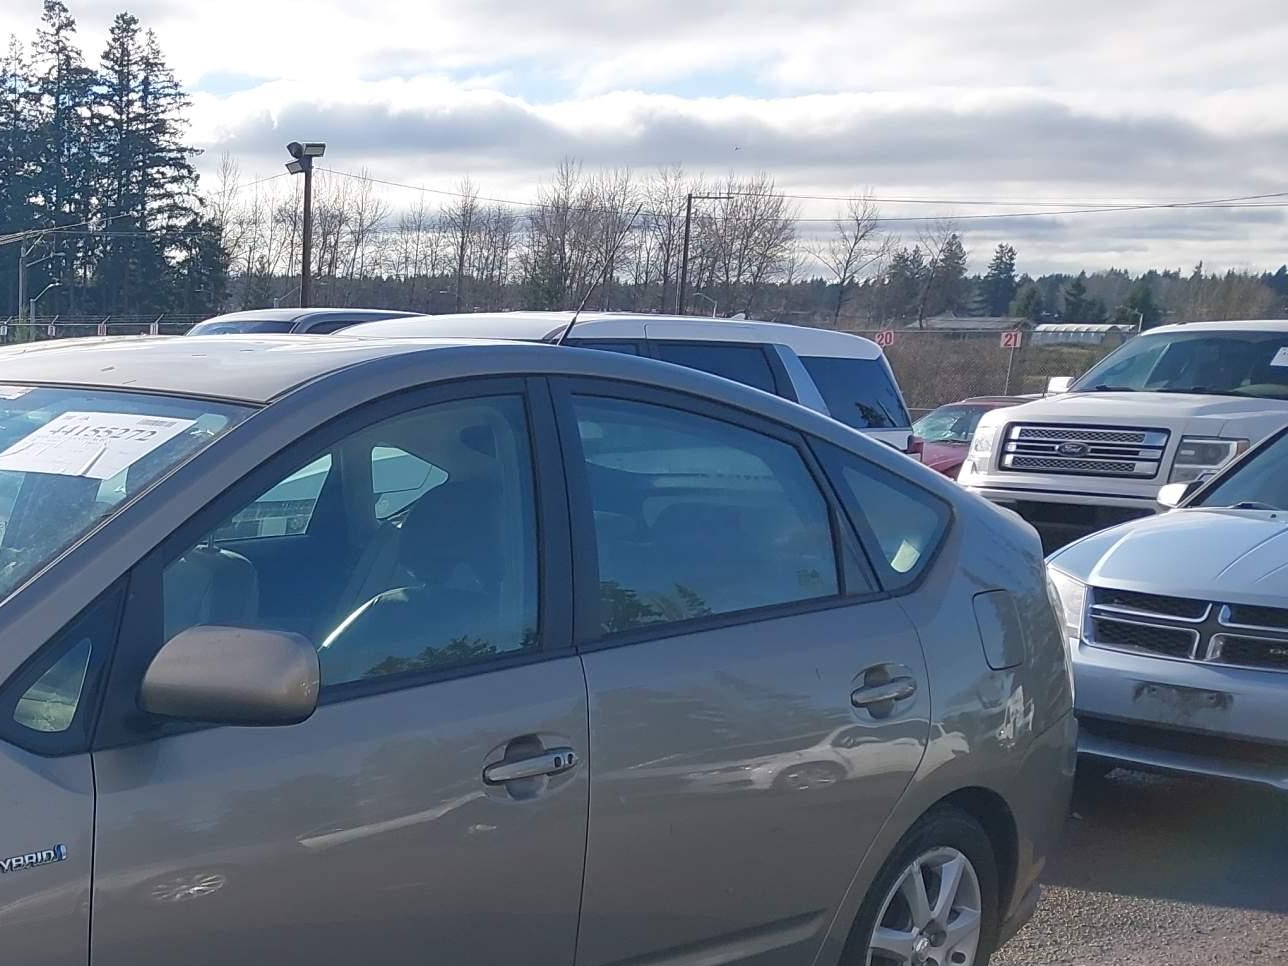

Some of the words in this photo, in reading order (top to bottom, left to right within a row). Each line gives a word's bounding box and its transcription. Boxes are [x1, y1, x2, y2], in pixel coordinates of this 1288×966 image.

[877, 332, 892, 345] 20
[1004, 333, 1018, 346] 21
[50, 424, 157, 441] 44155272
